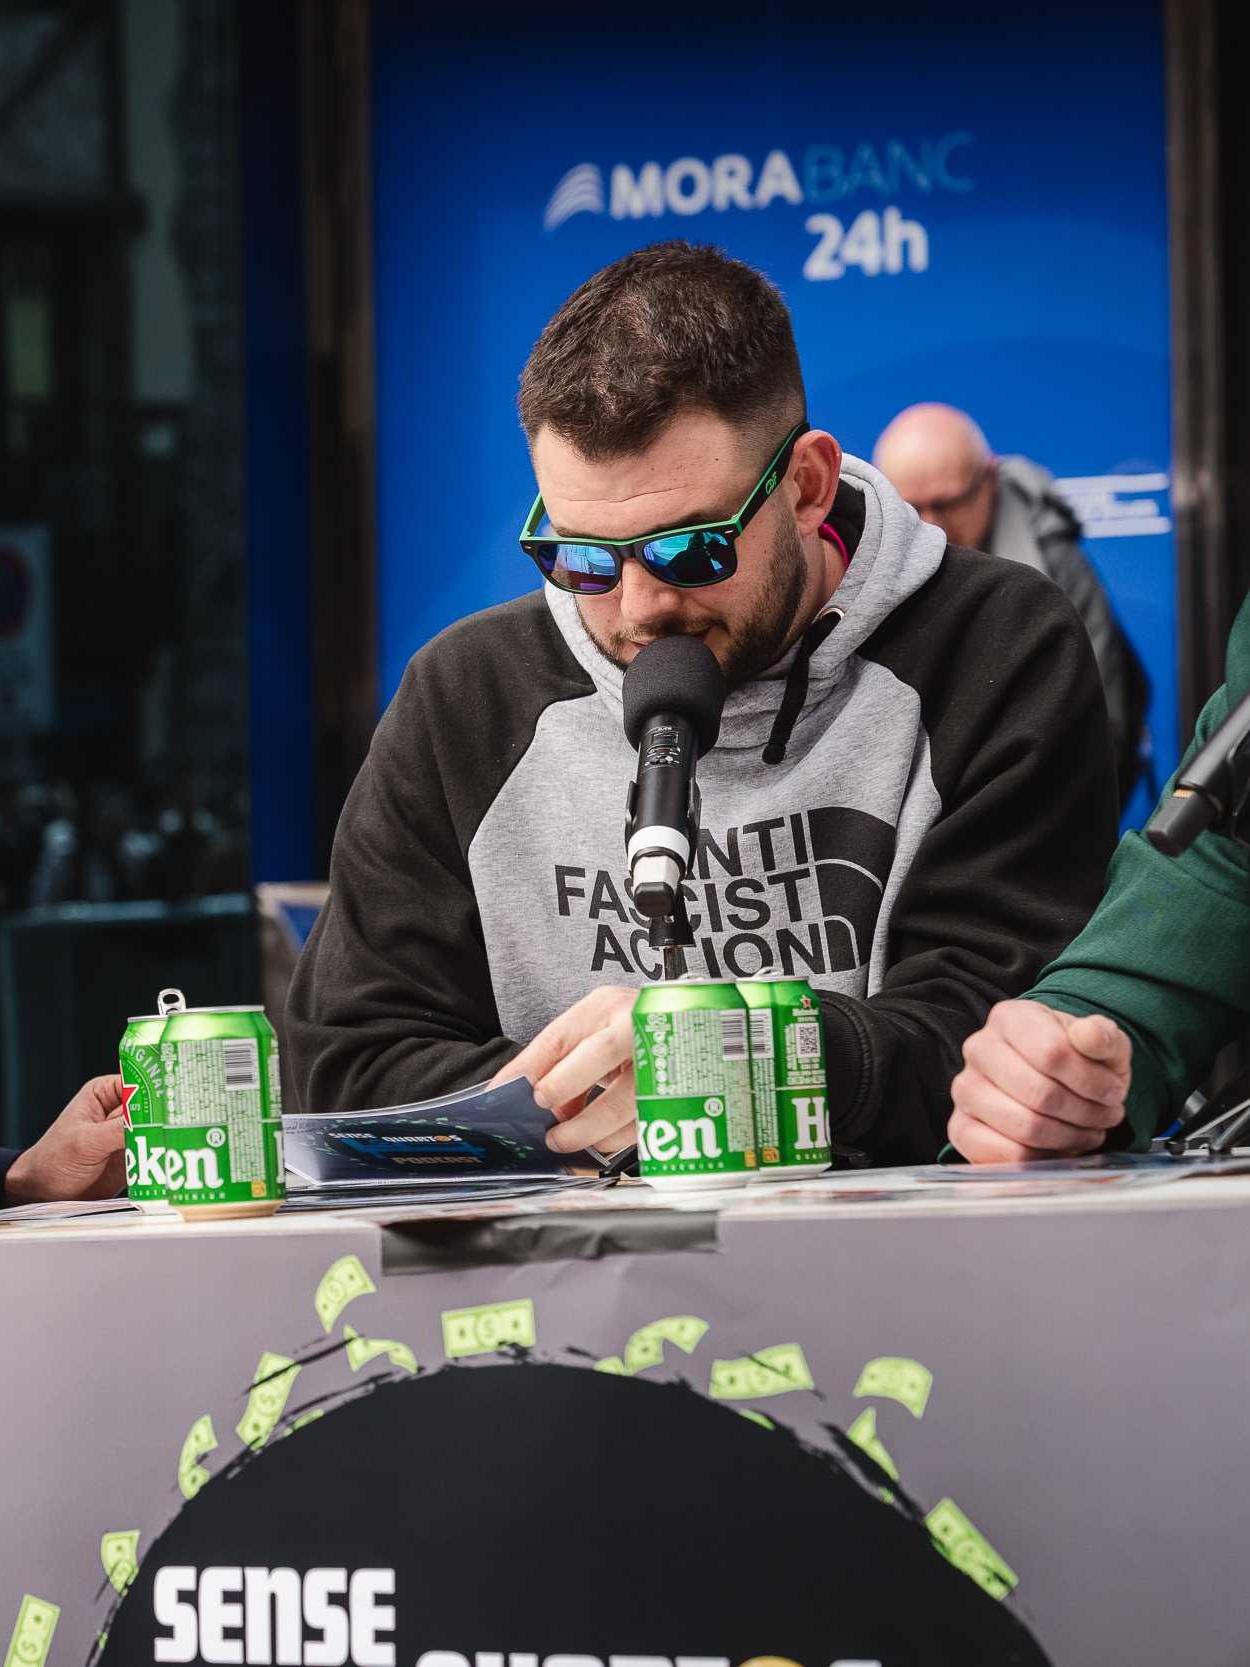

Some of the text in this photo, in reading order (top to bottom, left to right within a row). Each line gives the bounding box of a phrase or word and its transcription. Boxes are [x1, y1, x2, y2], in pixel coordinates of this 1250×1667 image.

[802, 205, 930, 281] 24h
[685, 813, 806, 881] NTI
[590, 922, 826, 981] ACION
